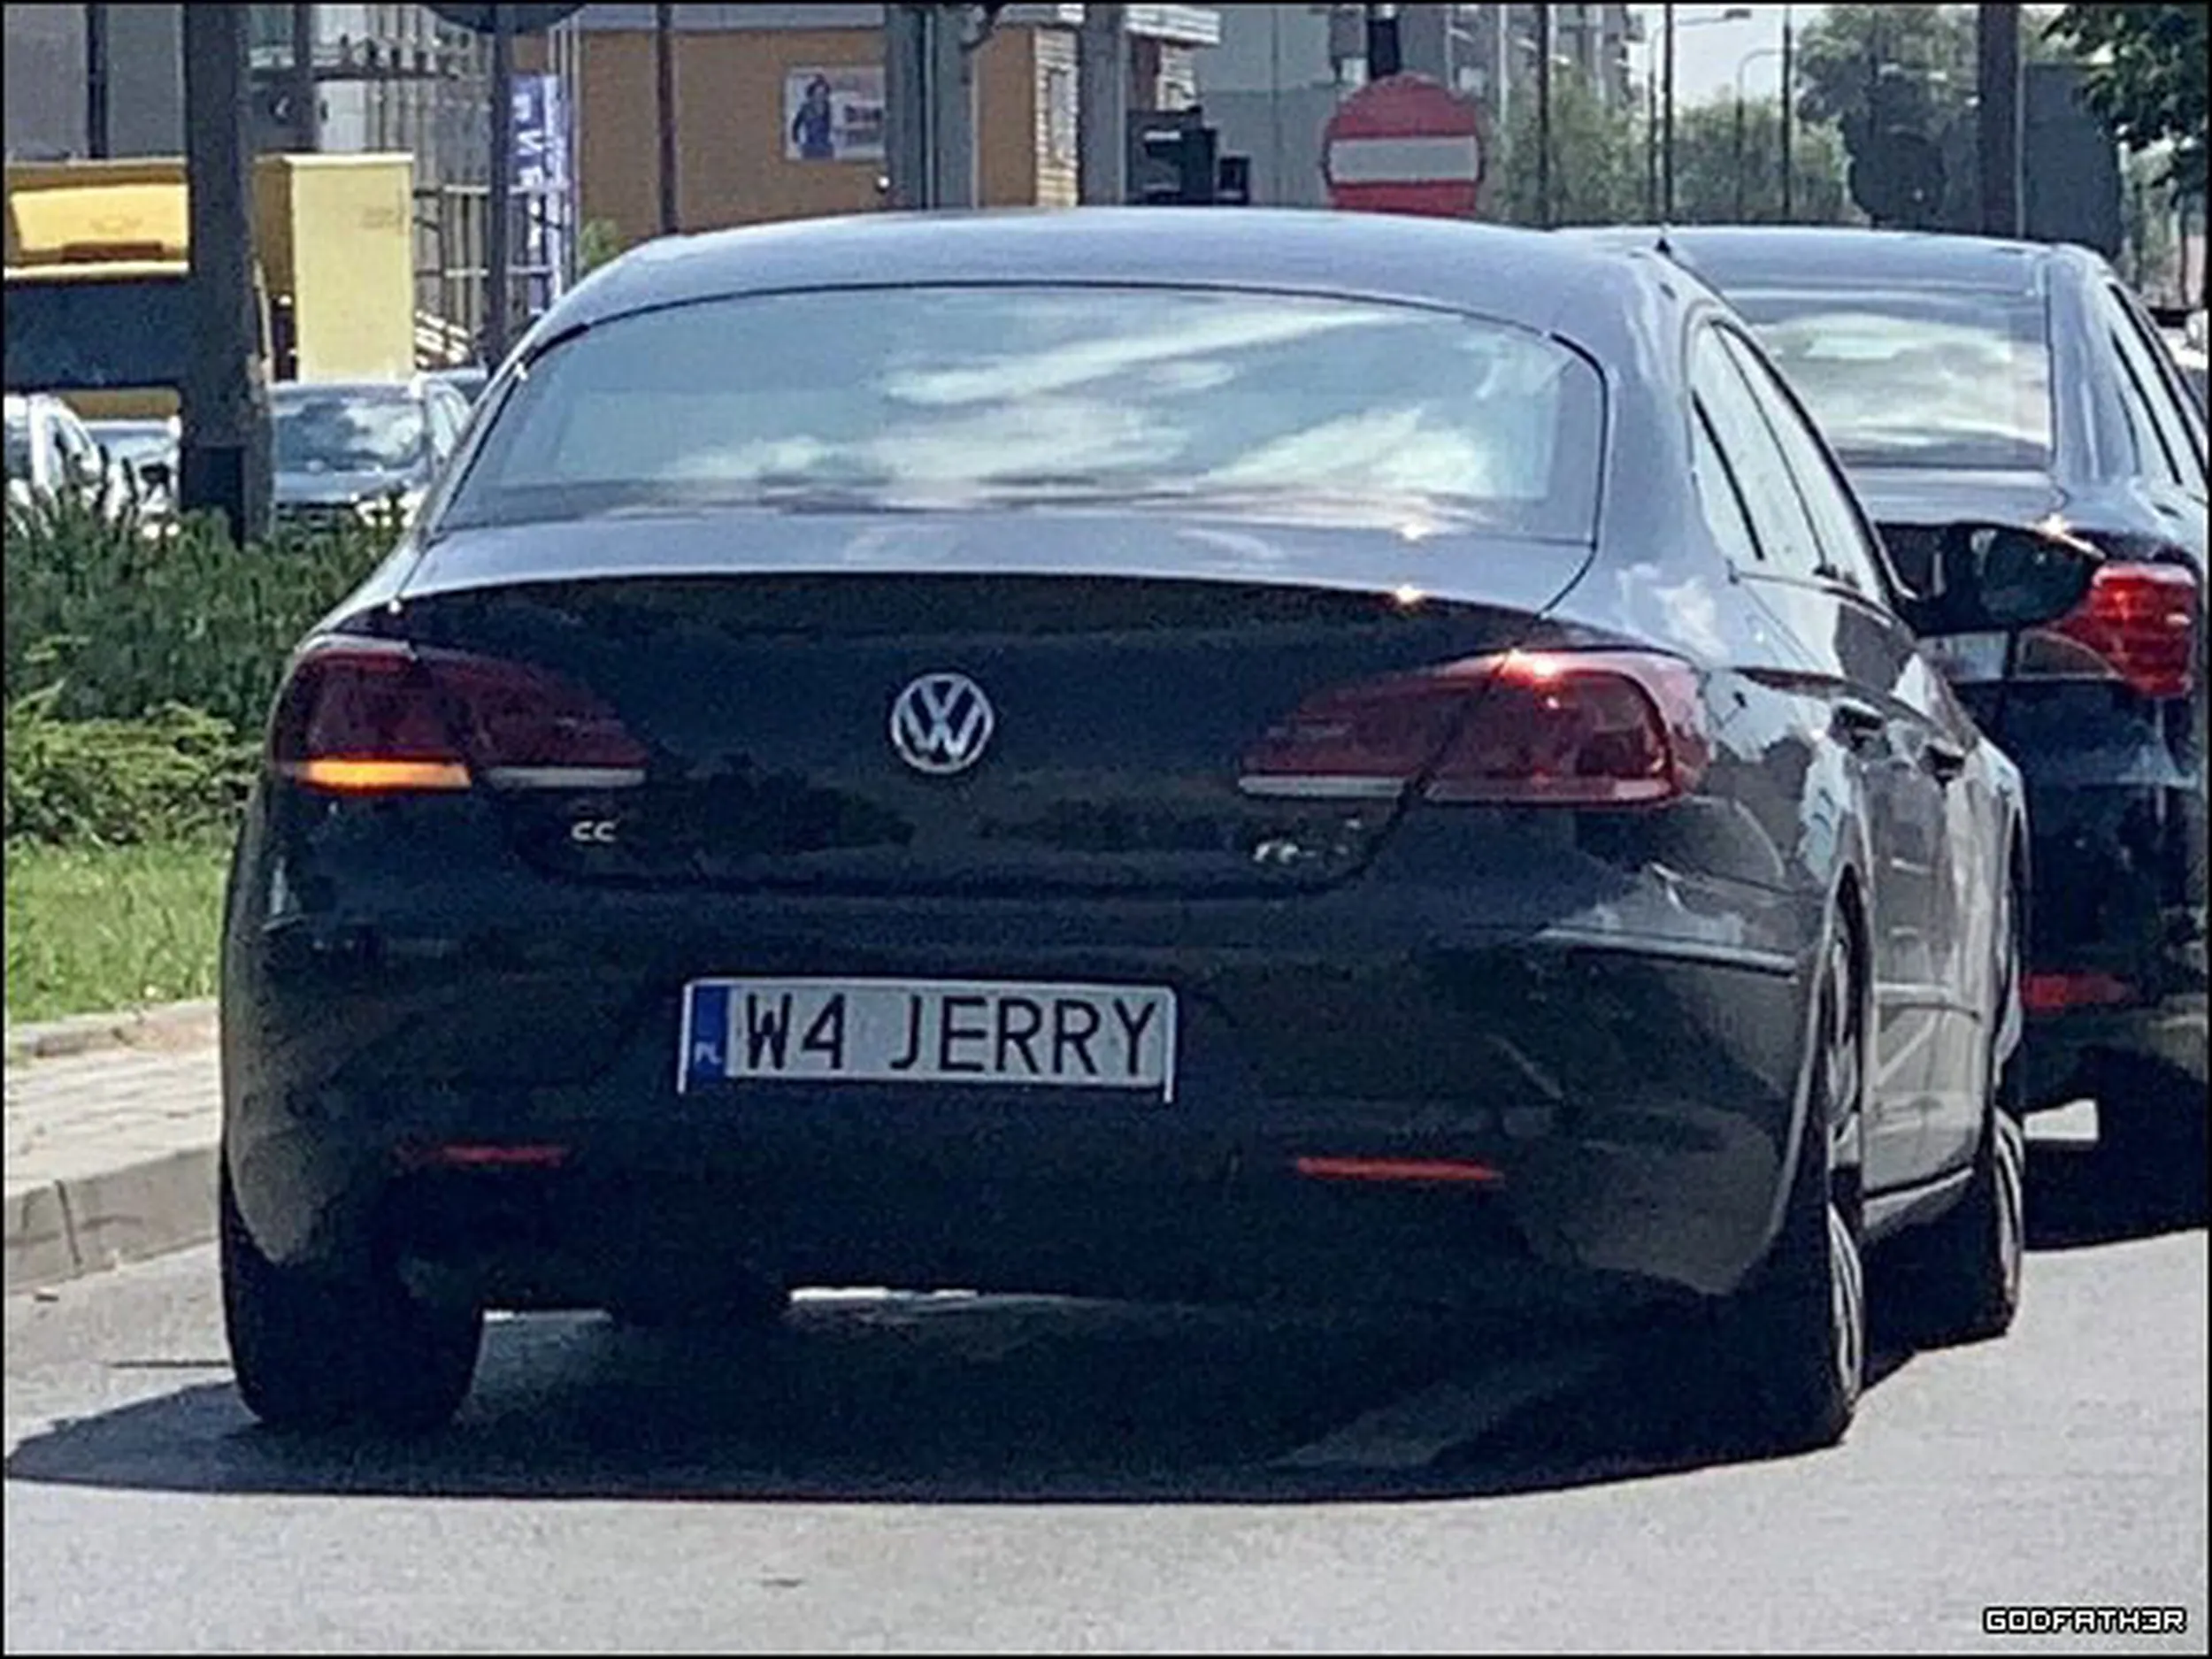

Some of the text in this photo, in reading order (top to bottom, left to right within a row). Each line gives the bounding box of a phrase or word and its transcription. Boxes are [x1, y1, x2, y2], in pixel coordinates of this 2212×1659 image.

[571, 820, 618, 842] CC
[746, 993, 1156, 1076] W4 JERRY
